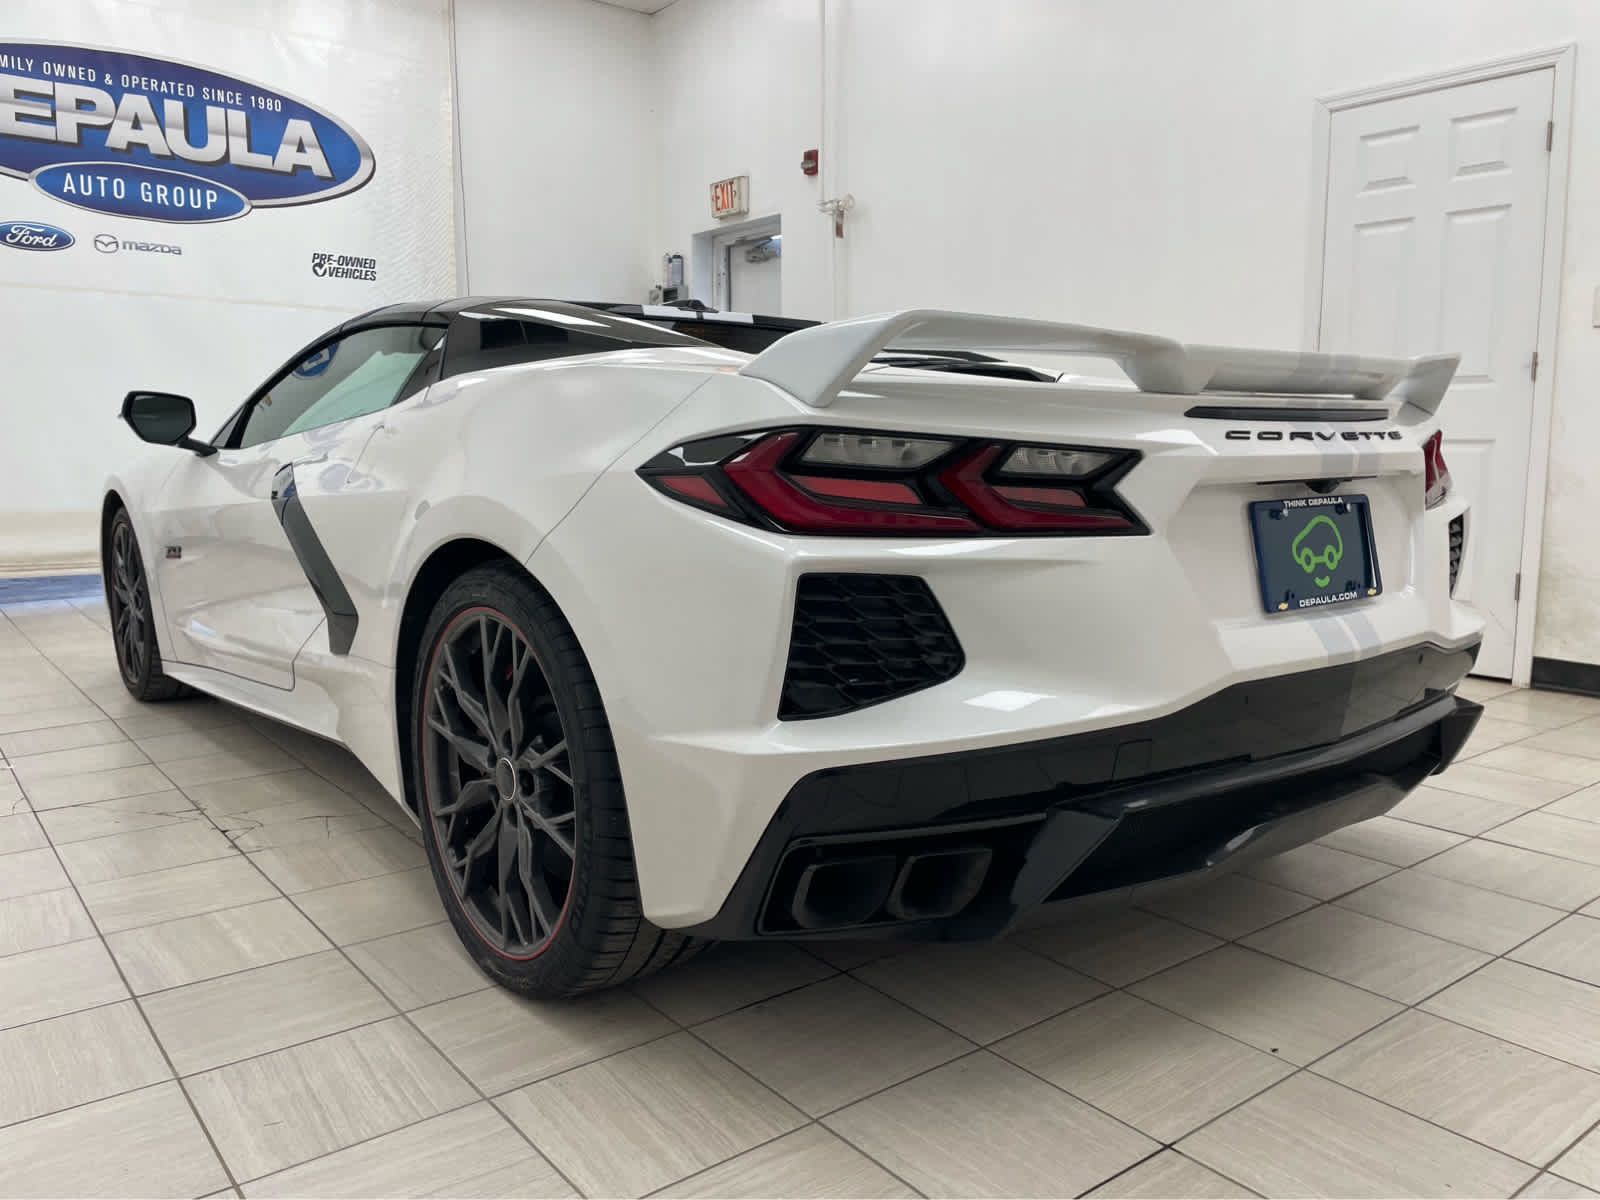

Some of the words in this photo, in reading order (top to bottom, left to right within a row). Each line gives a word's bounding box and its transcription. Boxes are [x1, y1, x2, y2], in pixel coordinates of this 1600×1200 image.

[43, 61, 96, 82] OWNED
[104, 73, 113, 86] &
[121, 74, 195, 98] OPERATED
[202, 87, 243, 106] SINCE
[250, 96, 282, 112] 1980
[0, 73, 334, 178] EPAULA
[63, 173, 126, 199] AUTO
[140, 183, 218, 210] GROUP
[714, 181, 735, 211] EXIT
[6, 225, 57, 247] Ford
[122, 240, 182, 255] mazda
[312, 253, 377, 269] PRE-OWNED
[328, 266, 377, 281] VEHICLES
[1225, 430, 1403, 441] CORVETTE
[1284, 499, 1306, 508] THINK
[1308, 496, 1344, 506] DEPAULA
[1299, 591, 1358, 607] DEPAULA.COM
